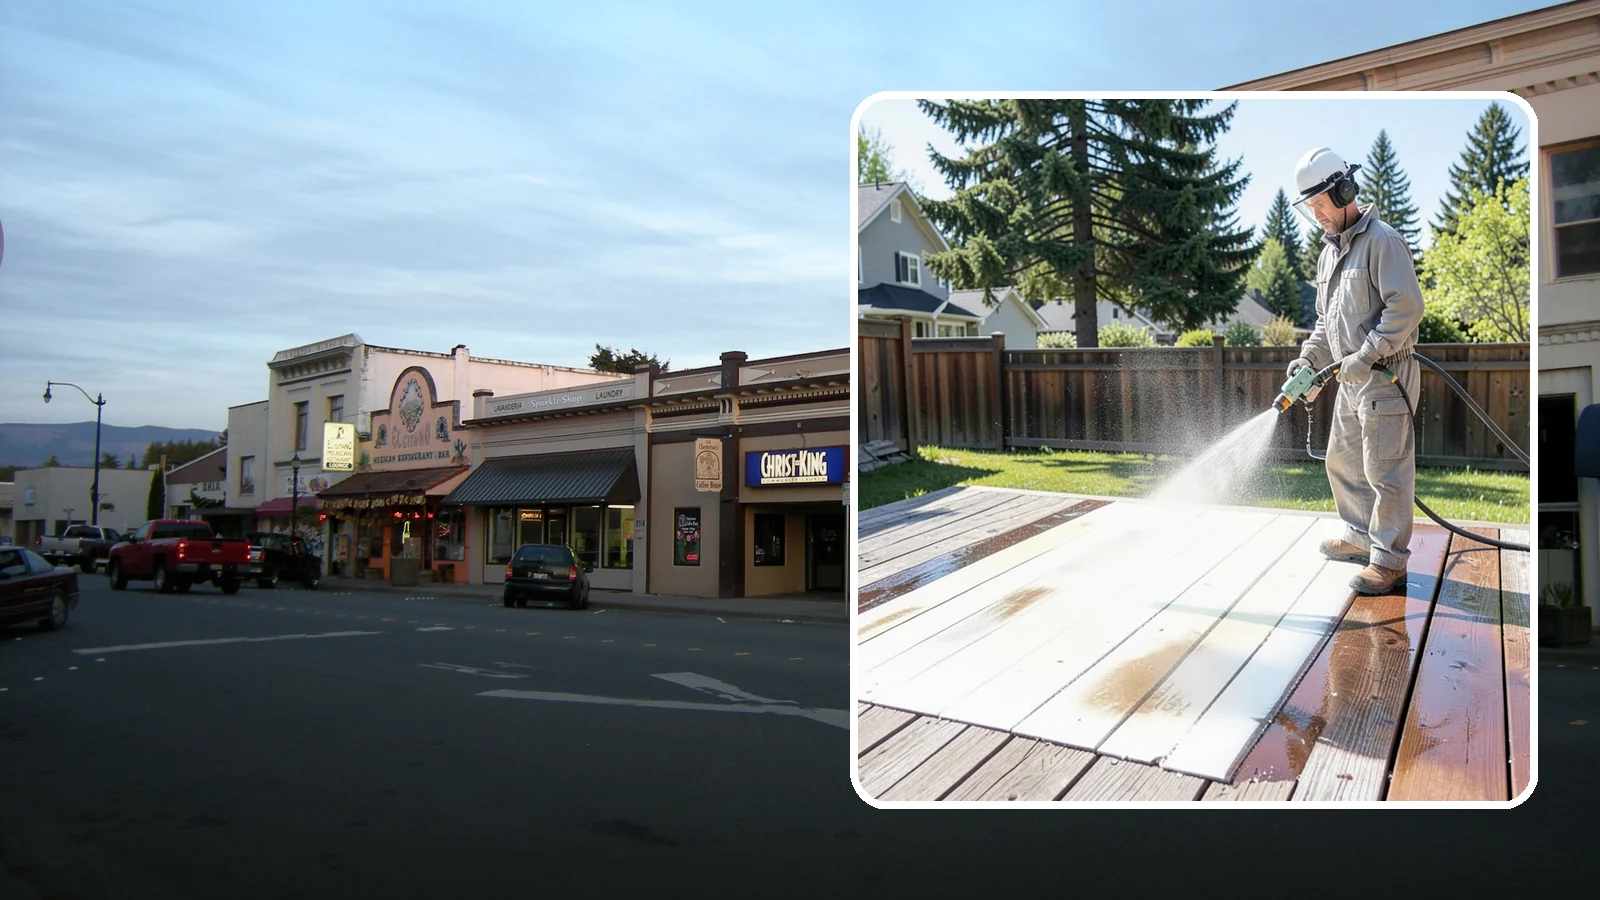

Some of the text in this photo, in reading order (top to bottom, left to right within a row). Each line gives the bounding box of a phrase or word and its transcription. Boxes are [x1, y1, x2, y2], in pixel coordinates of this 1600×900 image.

[531, 394, 582, 409] Sparkle Shop
[595, 389, 623, 400] LAUNDRY
[493, 402, 522, 413] LAVANDERIA
[392, 425, 401, 449] EL
[373, 455, 396, 464] MEXICAN
[397, 451, 433, 462] RESTAURANT
[438, 450, 450, 459] BAR
[761, 450, 827, 478] CHRIST KING
